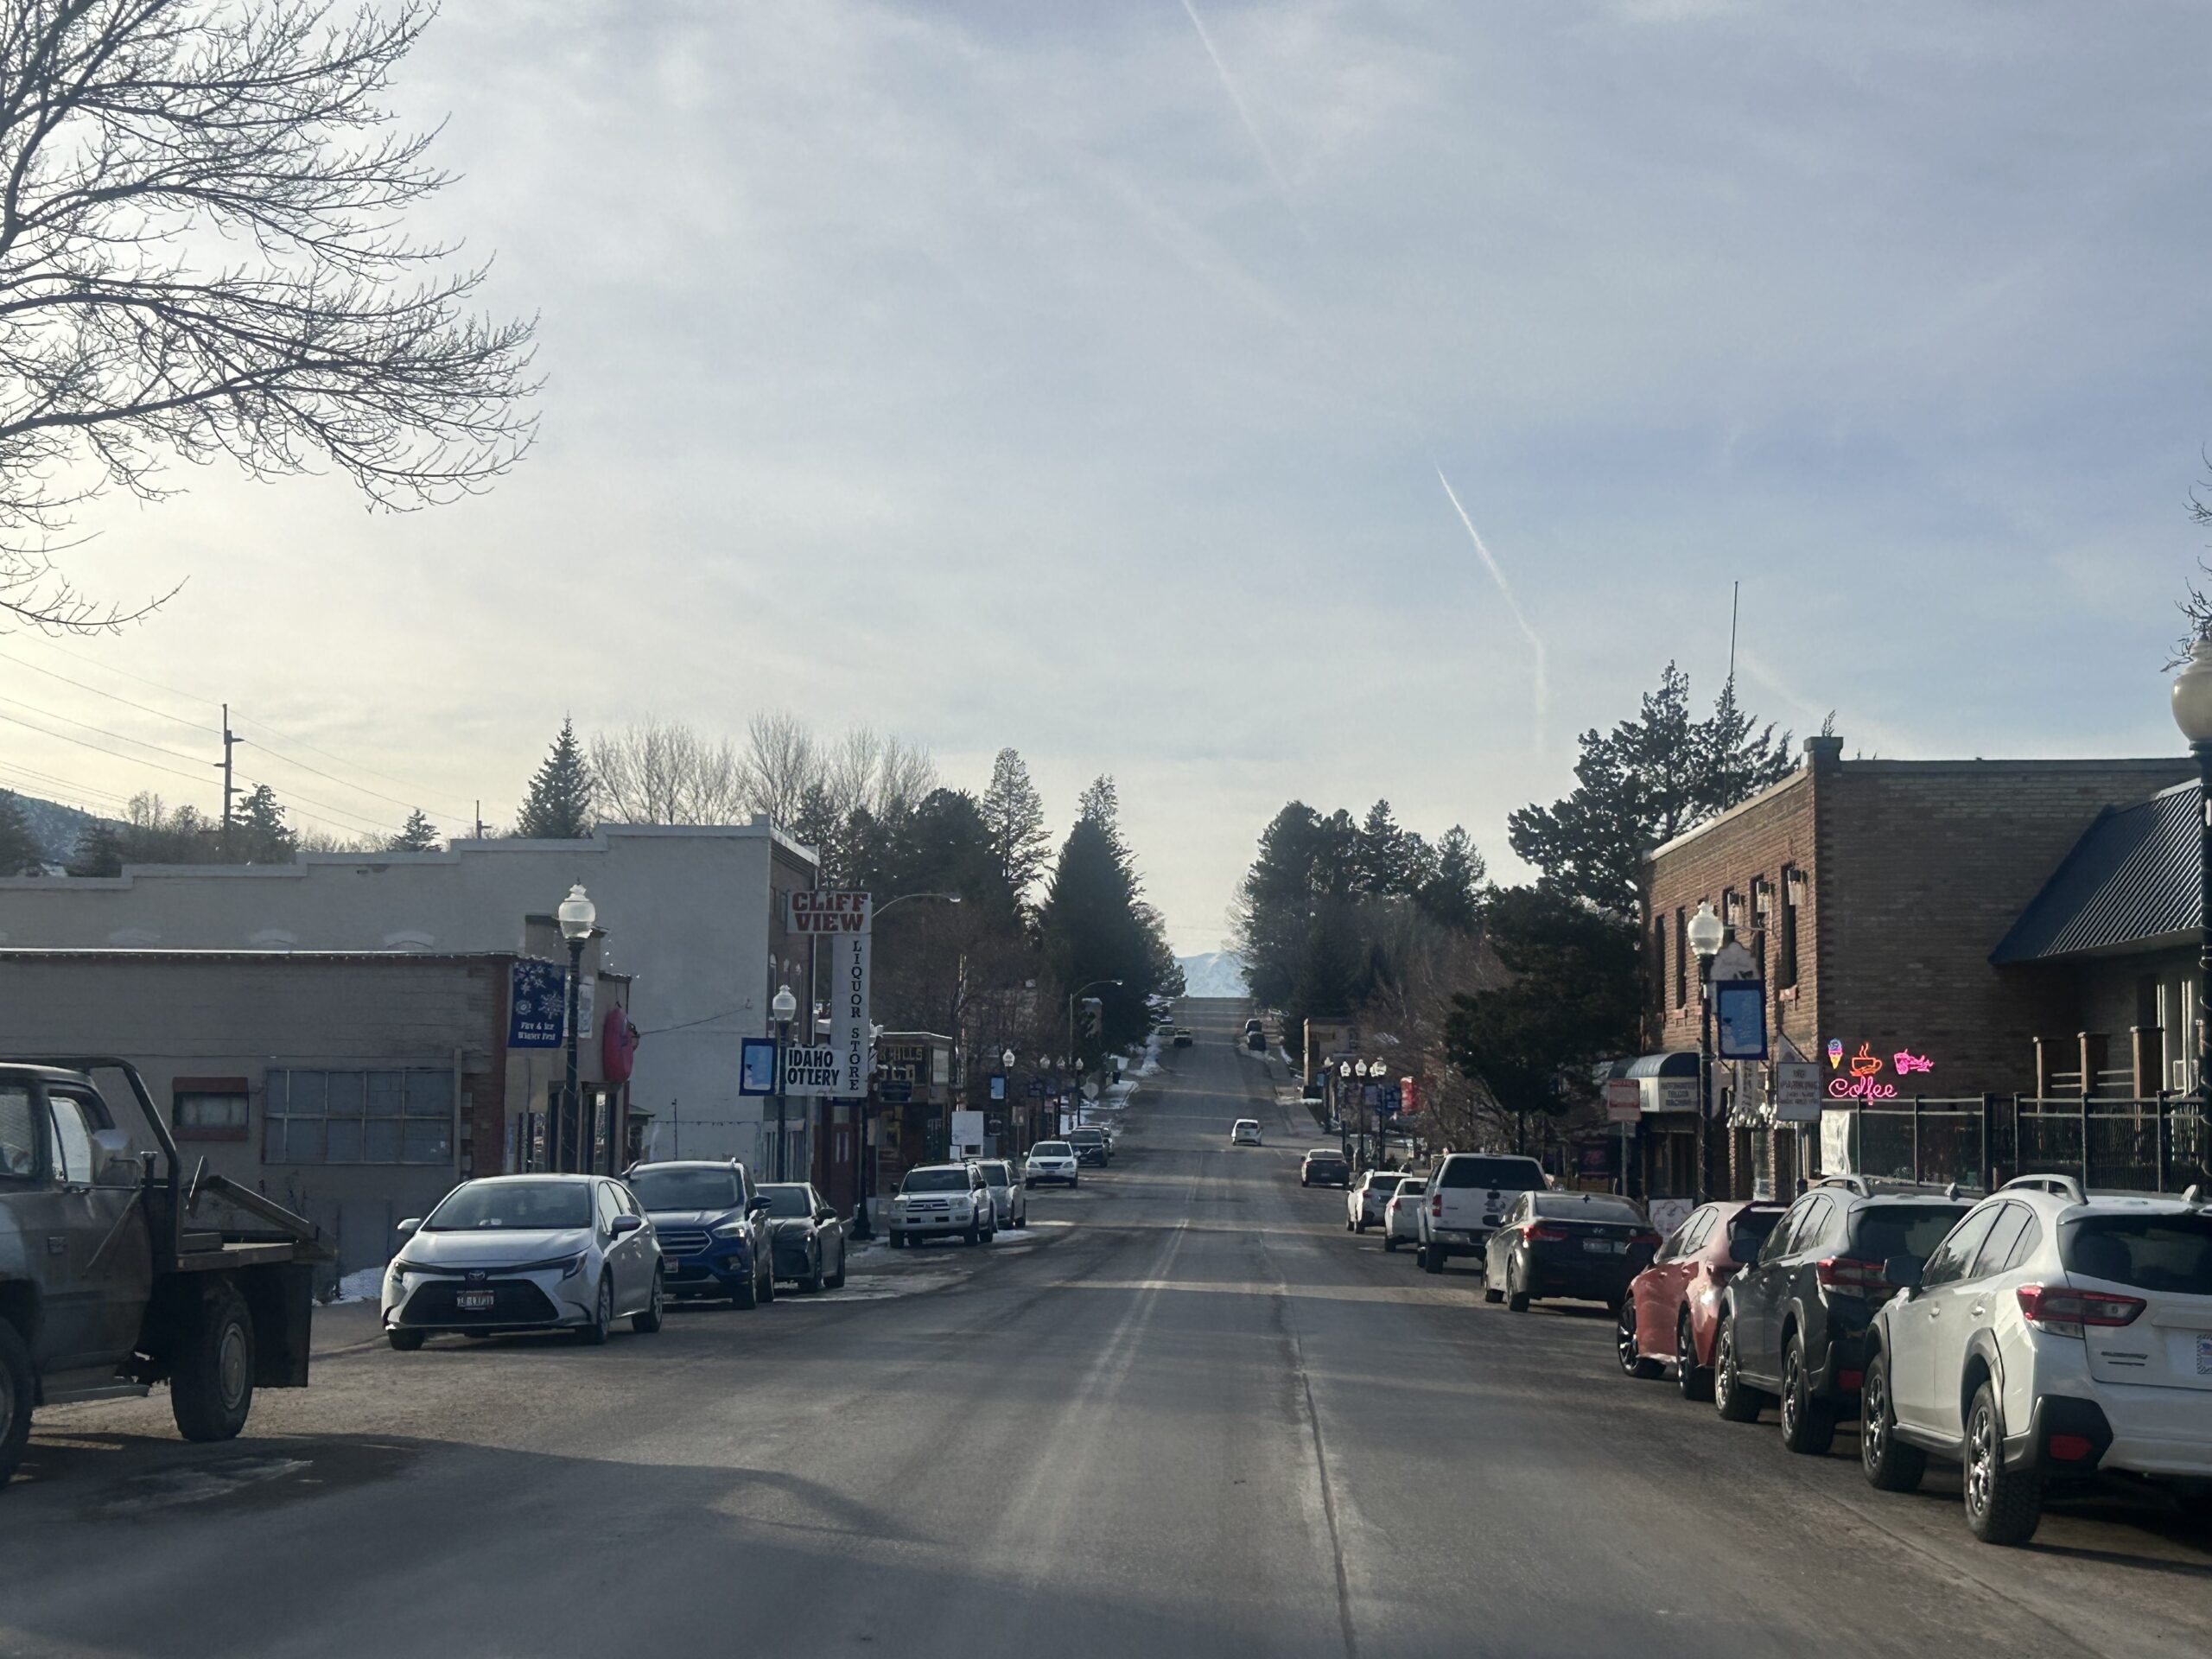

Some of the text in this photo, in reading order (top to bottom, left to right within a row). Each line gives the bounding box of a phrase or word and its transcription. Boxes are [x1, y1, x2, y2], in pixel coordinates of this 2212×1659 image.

[792, 891, 868, 912] CLIFF
[795, 912, 864, 931] VIEW
[849, 940, 862, 1090] LIQUOR STORE
[788, 1049, 834, 1068] IDAHO
[787, 1068, 840, 1085] OTTERY
[1828, 1076, 1897, 1105] Coffee
